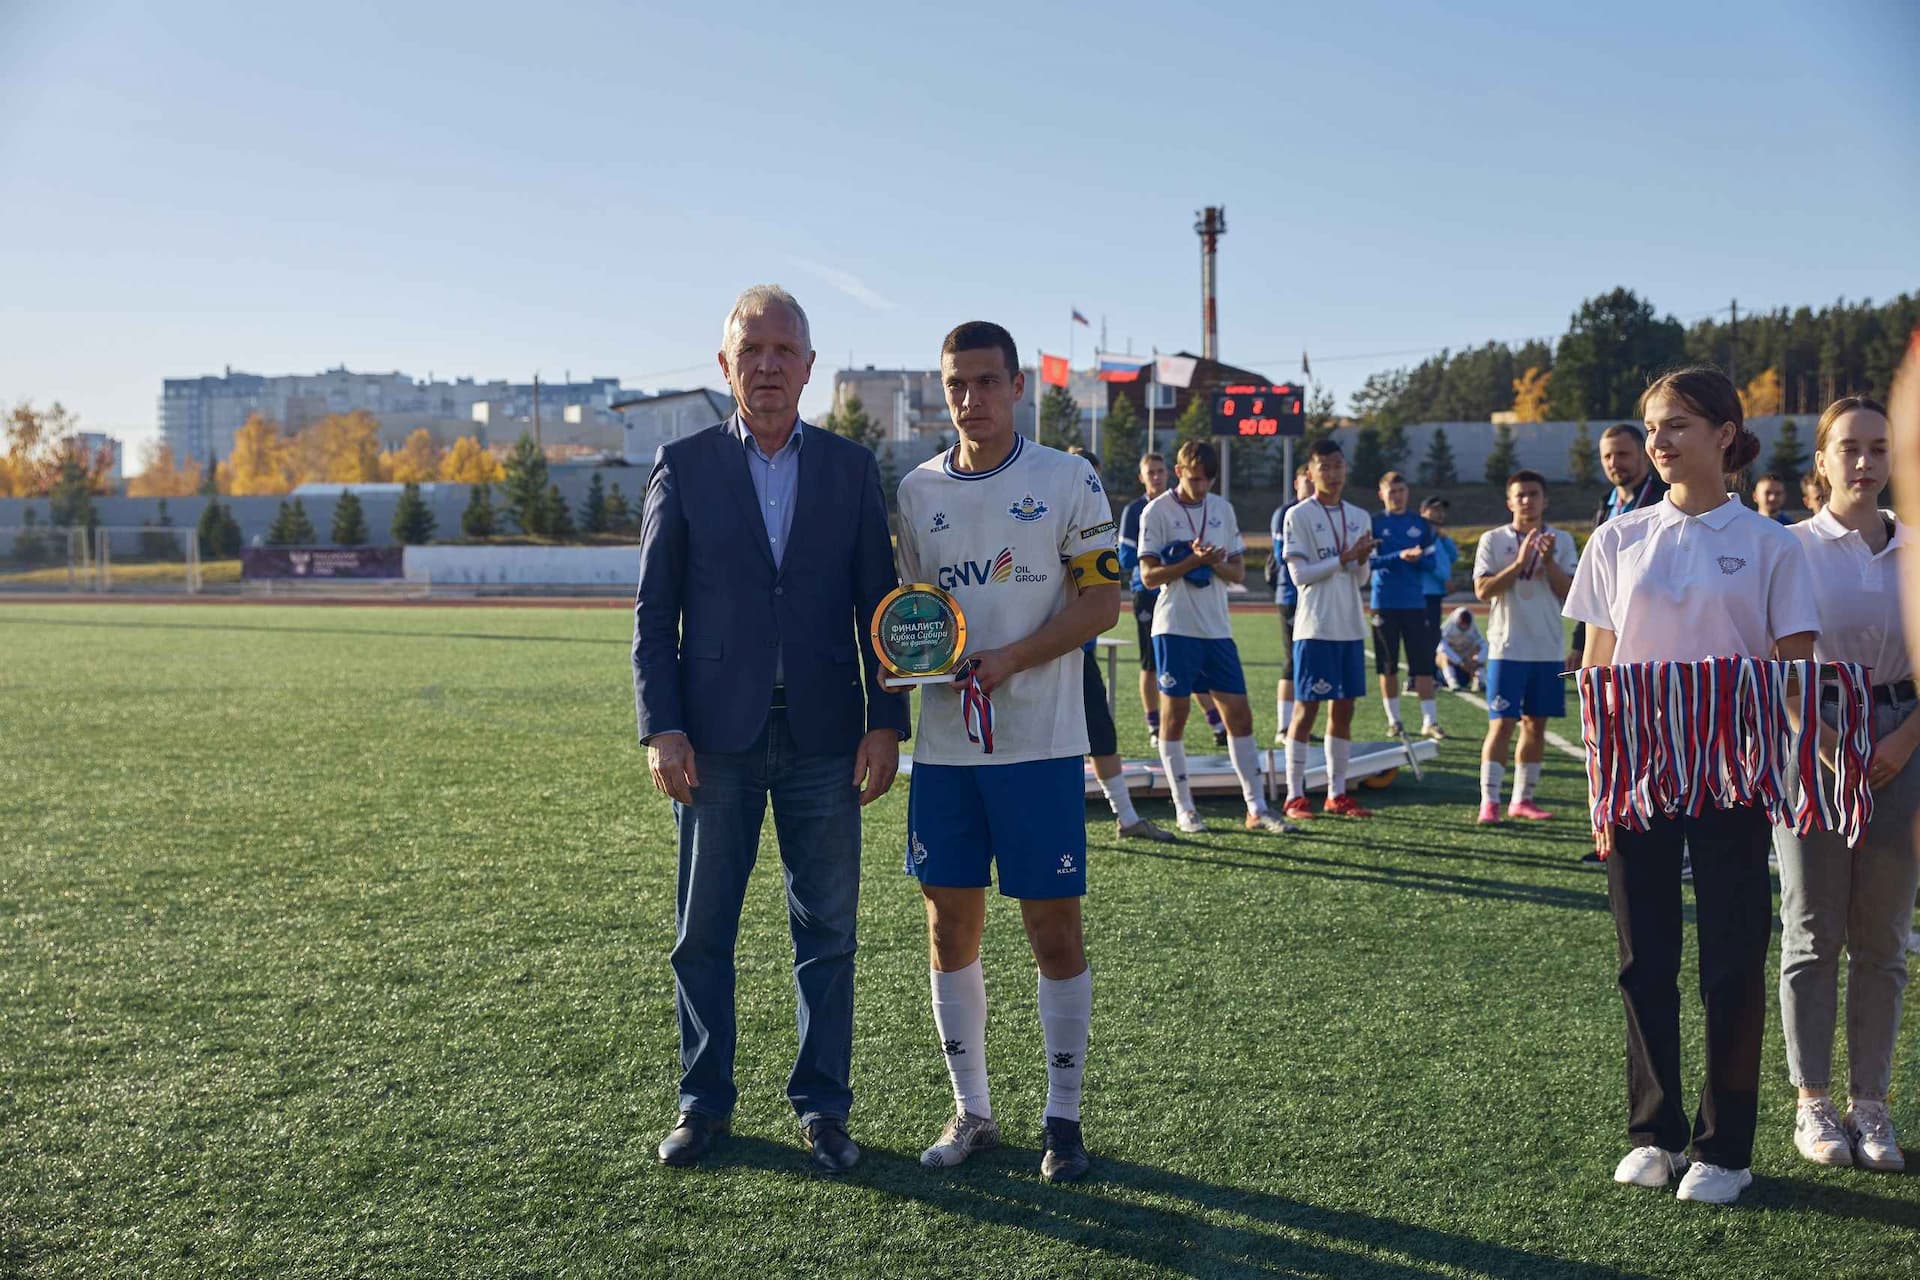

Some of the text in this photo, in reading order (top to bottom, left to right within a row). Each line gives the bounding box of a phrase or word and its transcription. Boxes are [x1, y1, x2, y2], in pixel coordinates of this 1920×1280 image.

[930, 524, 950, 533] KELME
[1014, 565, 1031, 574] OIL
[938, 560, 991, 591] GNV
[1014, 574, 1048, 583] GROUP
[891, 621, 945, 633] ФИНАЛИСТУ
[890, 630, 948, 644] Кубка Сибири
